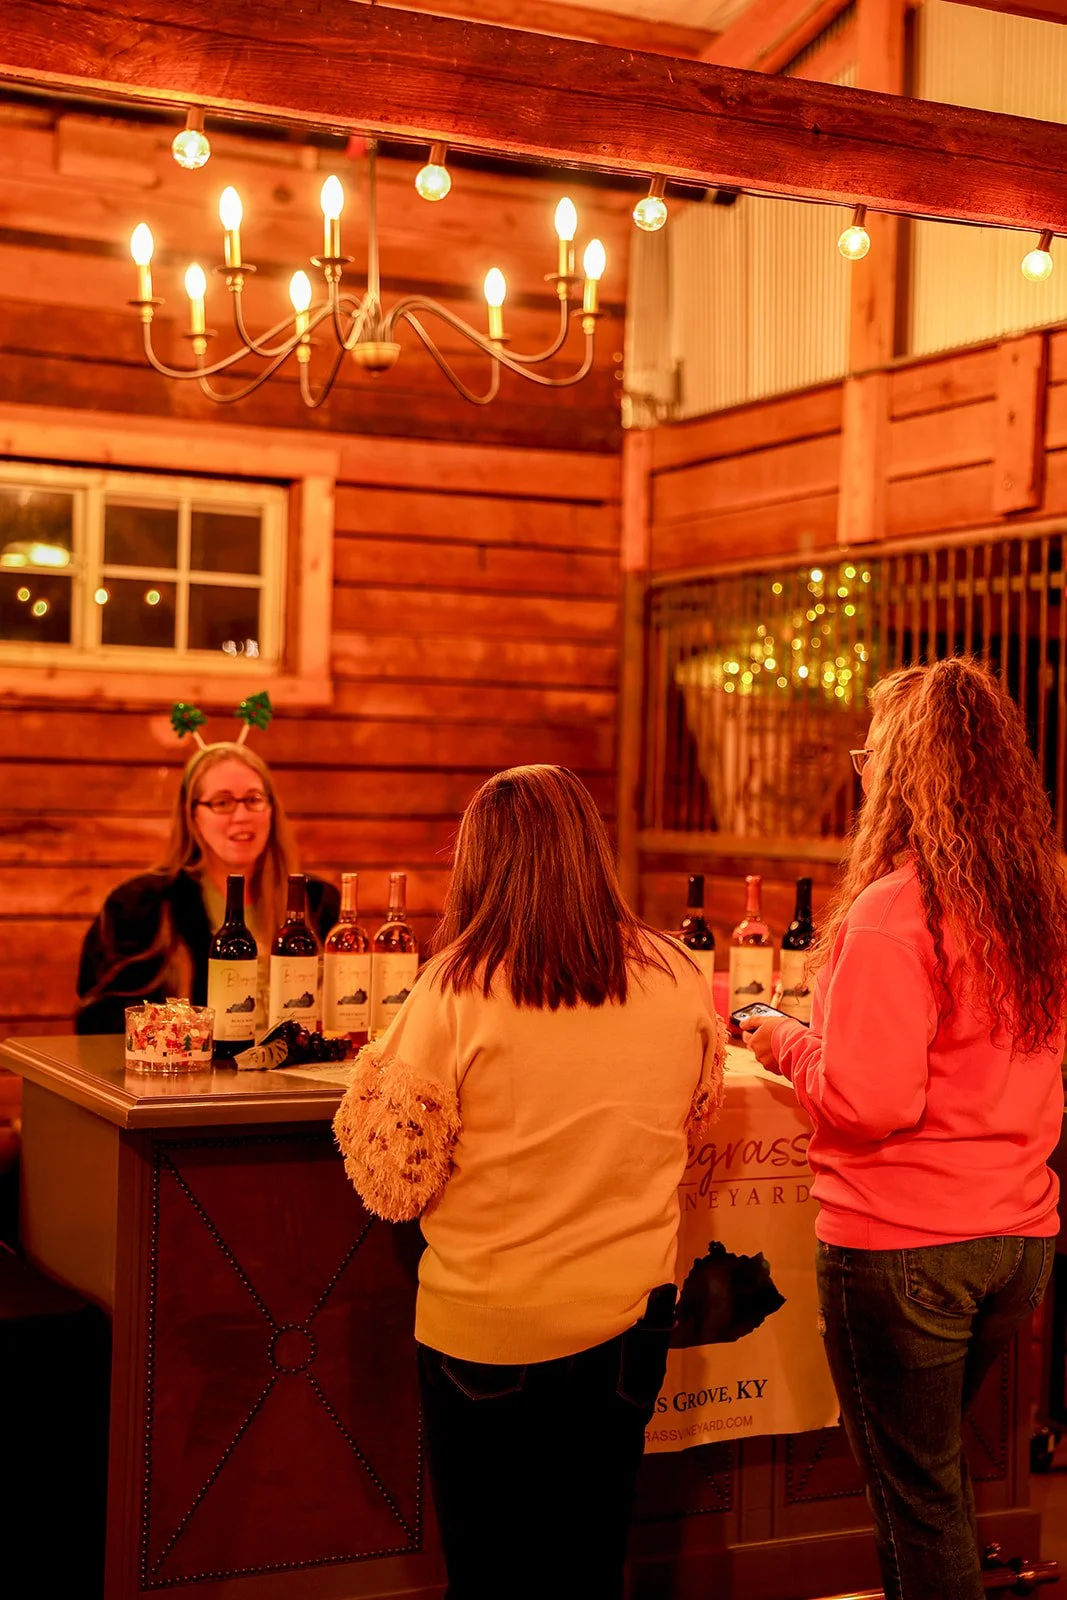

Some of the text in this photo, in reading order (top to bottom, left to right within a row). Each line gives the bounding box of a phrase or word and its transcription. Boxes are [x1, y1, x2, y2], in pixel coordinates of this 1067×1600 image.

[672, 1386, 733, 1412] GROVE,
[736, 1378, 768, 1400] KY
[645, 1415, 753, 1442] RASSVNEYARD.COM
